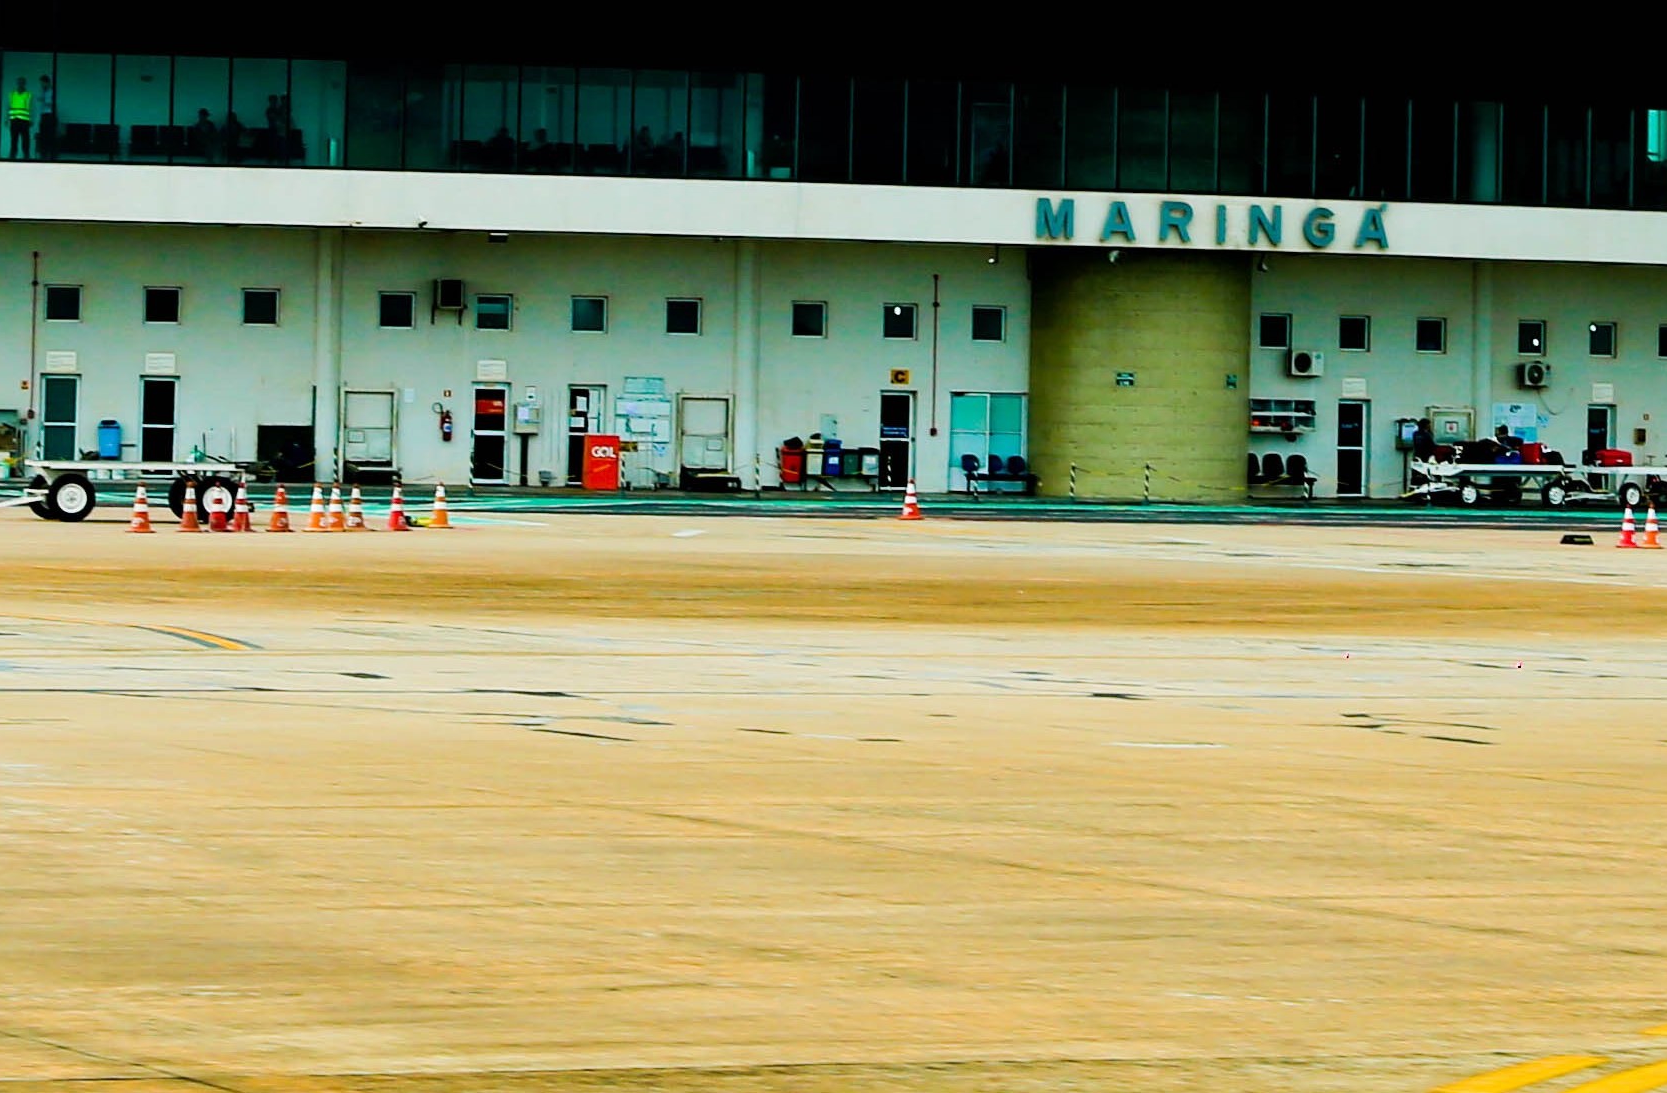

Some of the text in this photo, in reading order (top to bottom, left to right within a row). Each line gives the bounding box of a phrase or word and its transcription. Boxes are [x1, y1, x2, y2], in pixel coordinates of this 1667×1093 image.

[1036, 198, 1389, 249] MARINGÁ
[894, 370, 906, 383] C
[591, 445, 617, 459] GOL
